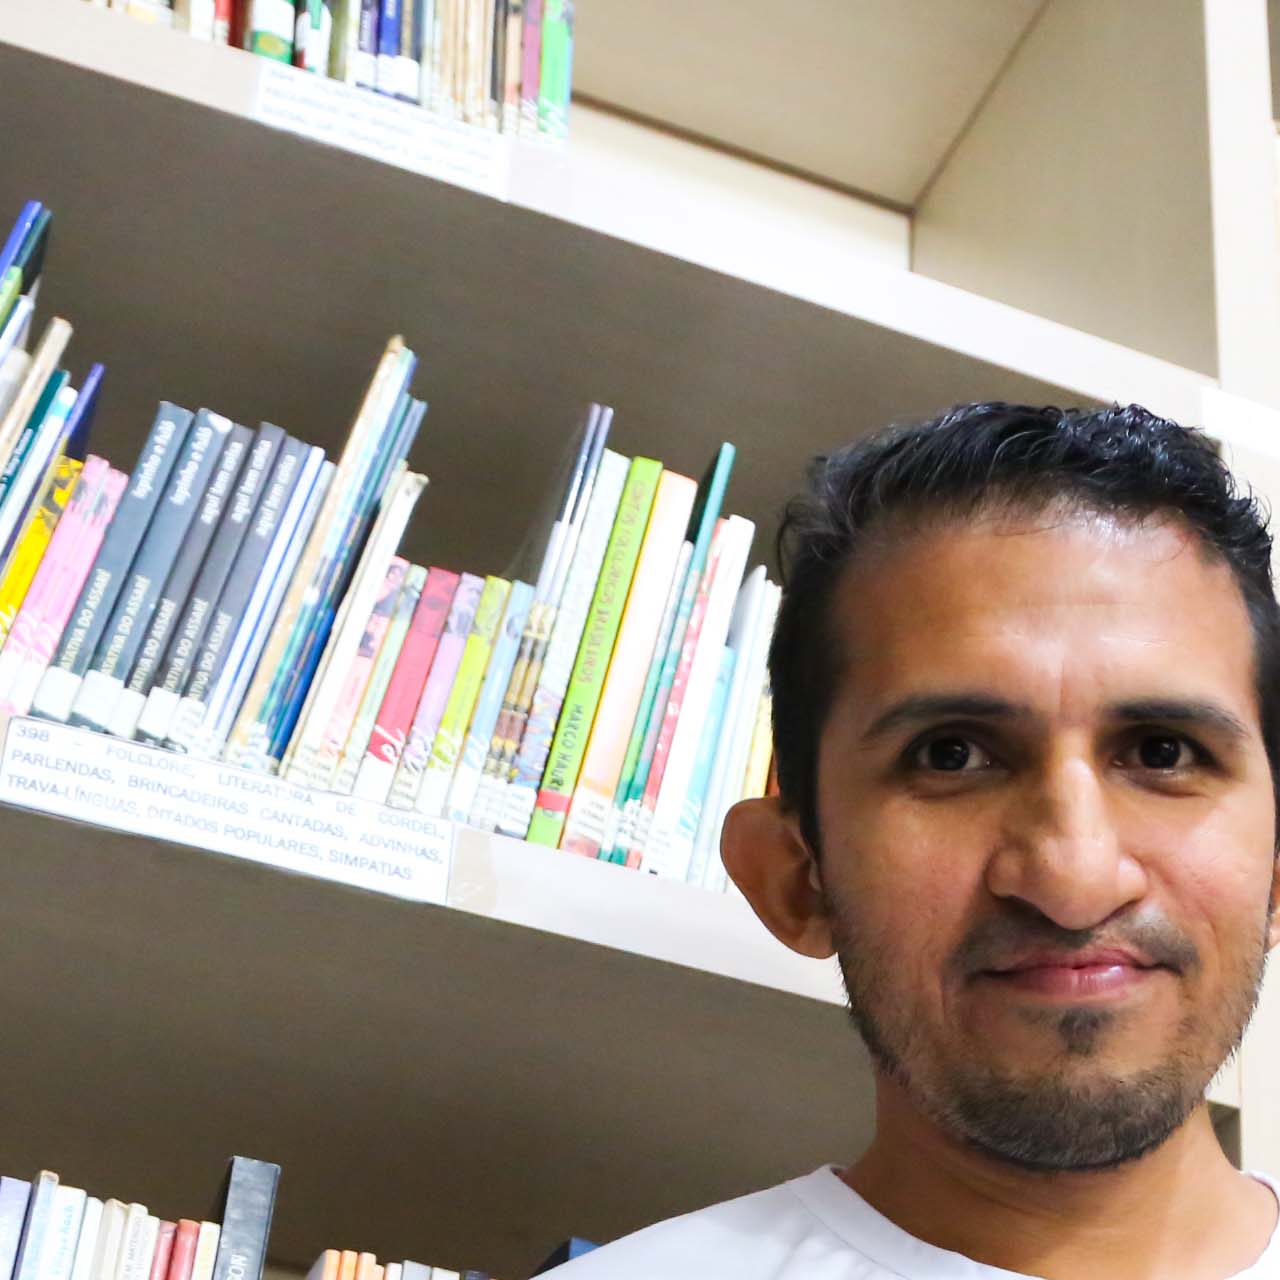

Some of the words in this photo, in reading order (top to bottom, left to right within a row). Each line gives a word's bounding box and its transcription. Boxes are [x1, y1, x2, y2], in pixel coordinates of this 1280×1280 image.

[11, 749, 116, 786] PARLENDAS,
[128, 776, 250, 816] BRINCADEIRAS
[16, 726, 50, 744] 398
[335, 799, 358, 817] DE
[147, 805, 218, 834] DITADOS
[328, 851, 413, 881] SIMPATIAS
